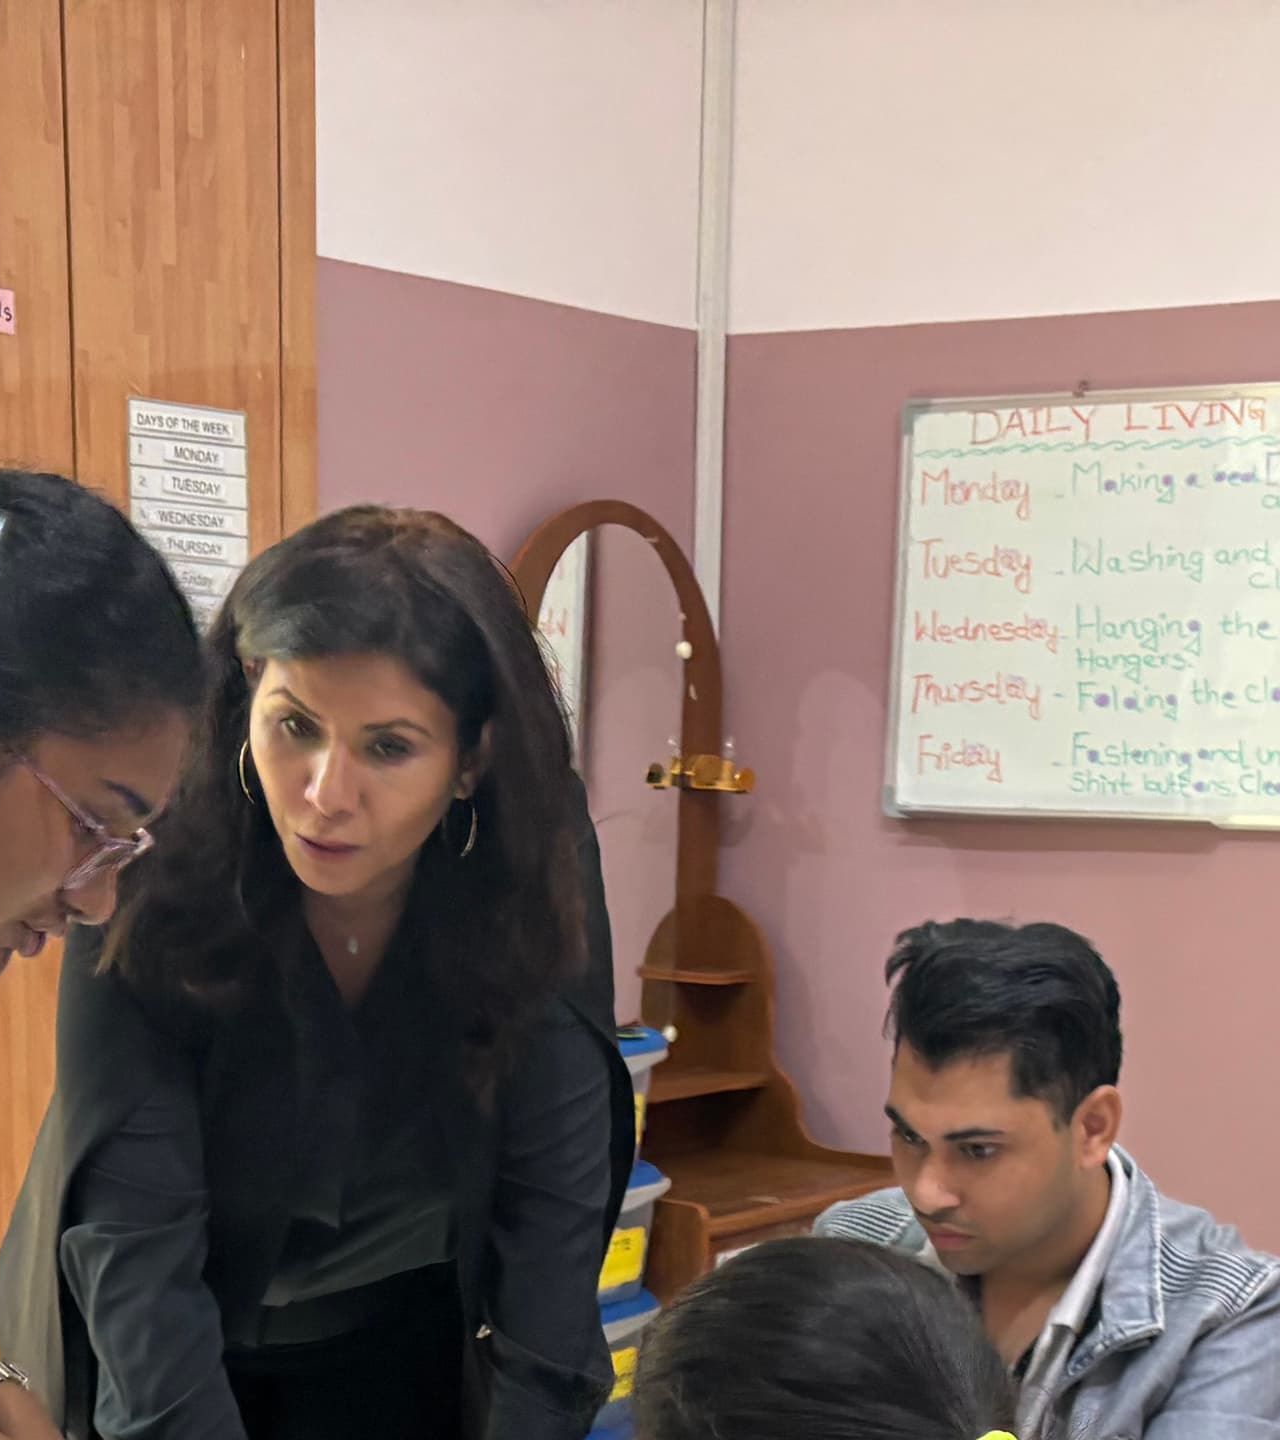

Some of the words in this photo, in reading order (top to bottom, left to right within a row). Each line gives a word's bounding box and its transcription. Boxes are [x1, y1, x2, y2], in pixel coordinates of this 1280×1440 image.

[136, 413, 165, 428] DAYS
[166, 416, 180, 429] OF
[181, 418, 200, 432] THE
[202, 421, 230, 434] WEEK
[969, 403, 1097, 445] DAILY
[1124, 396, 1267, 431] LIVING
[174, 446, 219, 463] MONDAY
[172, 476, 220, 496] TUESDAY
[920, 467, 1032, 521] Monday
[1072, 461, 1175, 504] Making
[157, 510, 224, 528] WEDNESDAY
[167, 536, 223, 555] THURSDAY
[920, 537, 1032, 594] Tuesday
[1072, 537, 1204, 583] Washing
[1215, 541, 1273, 567] and
[1076, 603, 1201, 656] Hanging
[1220, 610, 1278, 640] the
[912, 671, 1041, 720] Thursday
[1076, 681, 1178, 721] Folding
[1191, 677, 1239, 708] the
[917, 734, 1003, 783] Friday
